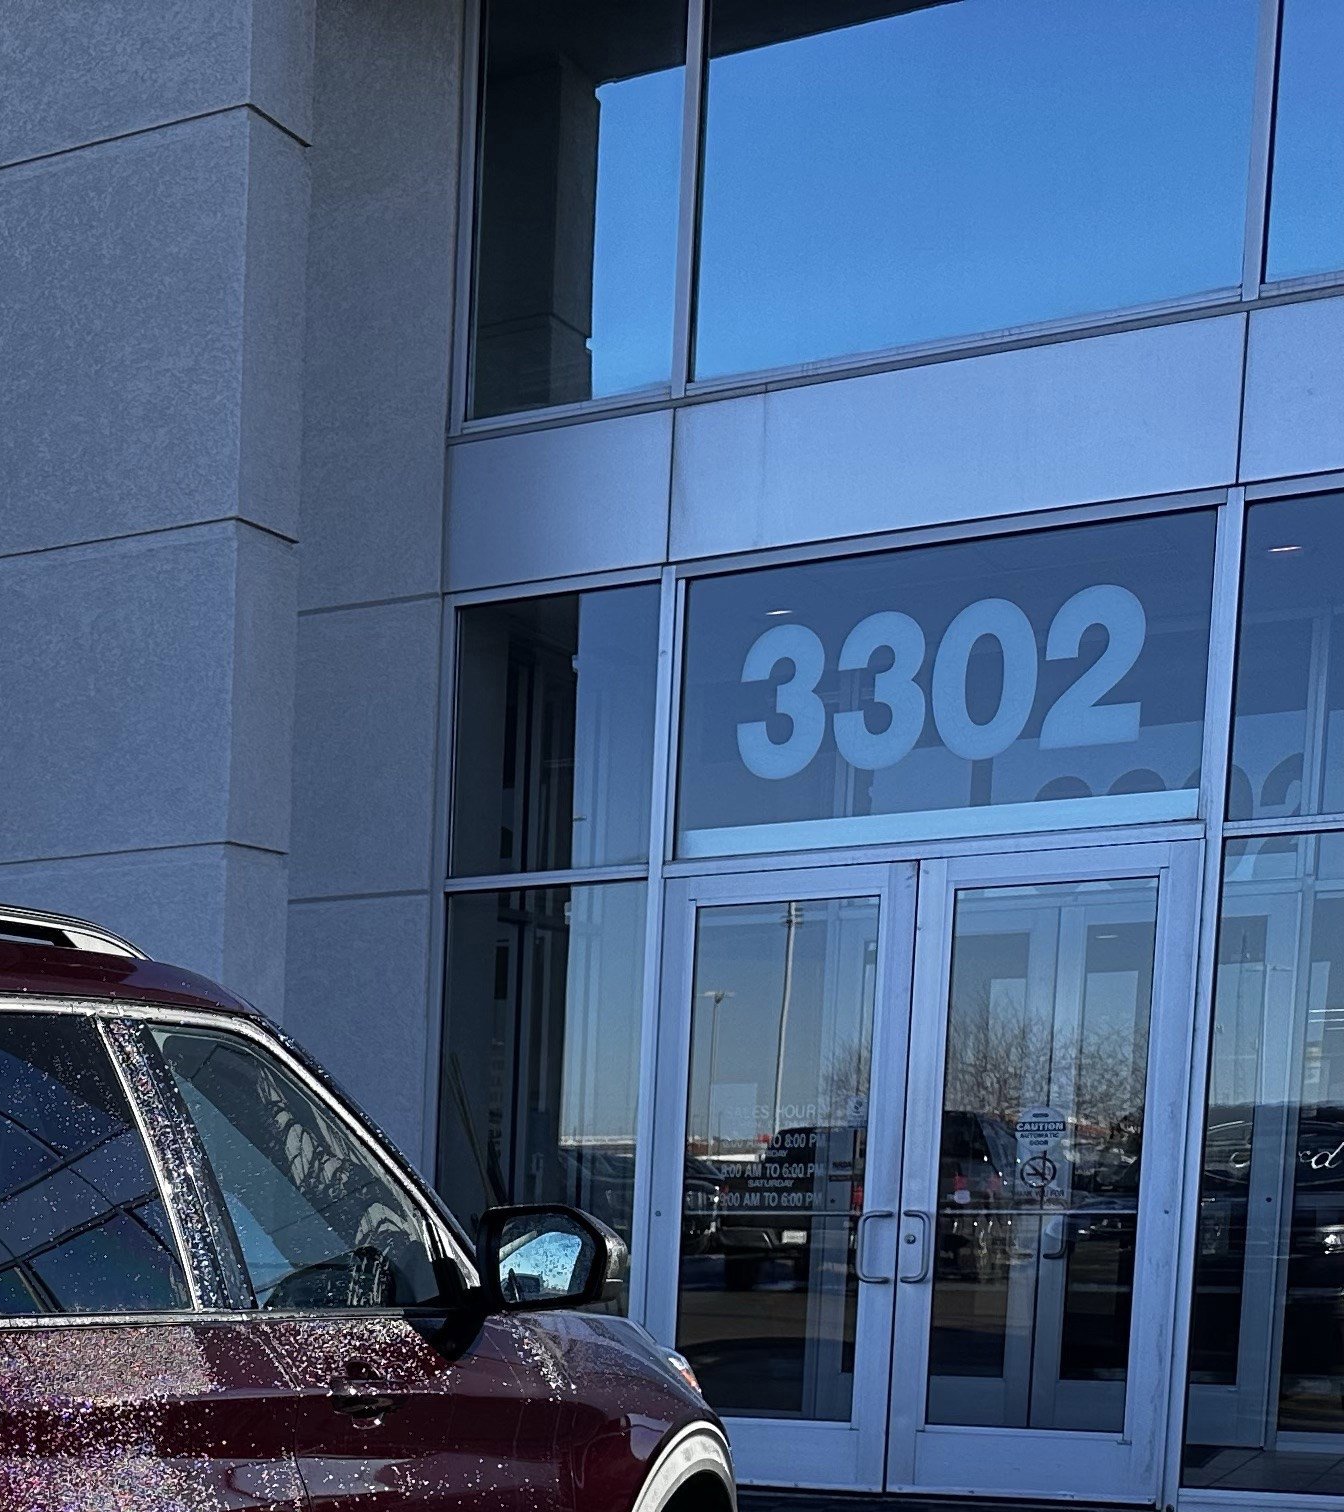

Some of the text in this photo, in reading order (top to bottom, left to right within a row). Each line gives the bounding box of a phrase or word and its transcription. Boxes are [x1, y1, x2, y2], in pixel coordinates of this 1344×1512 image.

[736, 584, 1146, 780] 3302
[1016, 1122, 1064, 1131] CAUTION
[744, 1163, 762, 1178] AM
[765, 1163, 779, 1178] TO
[782, 1163, 805, 1178] 6:00
[743, 1192, 761, 1207] AM
[764, 1192, 779, 1207] TO
[780, 1192, 803, 1207] 6:00
